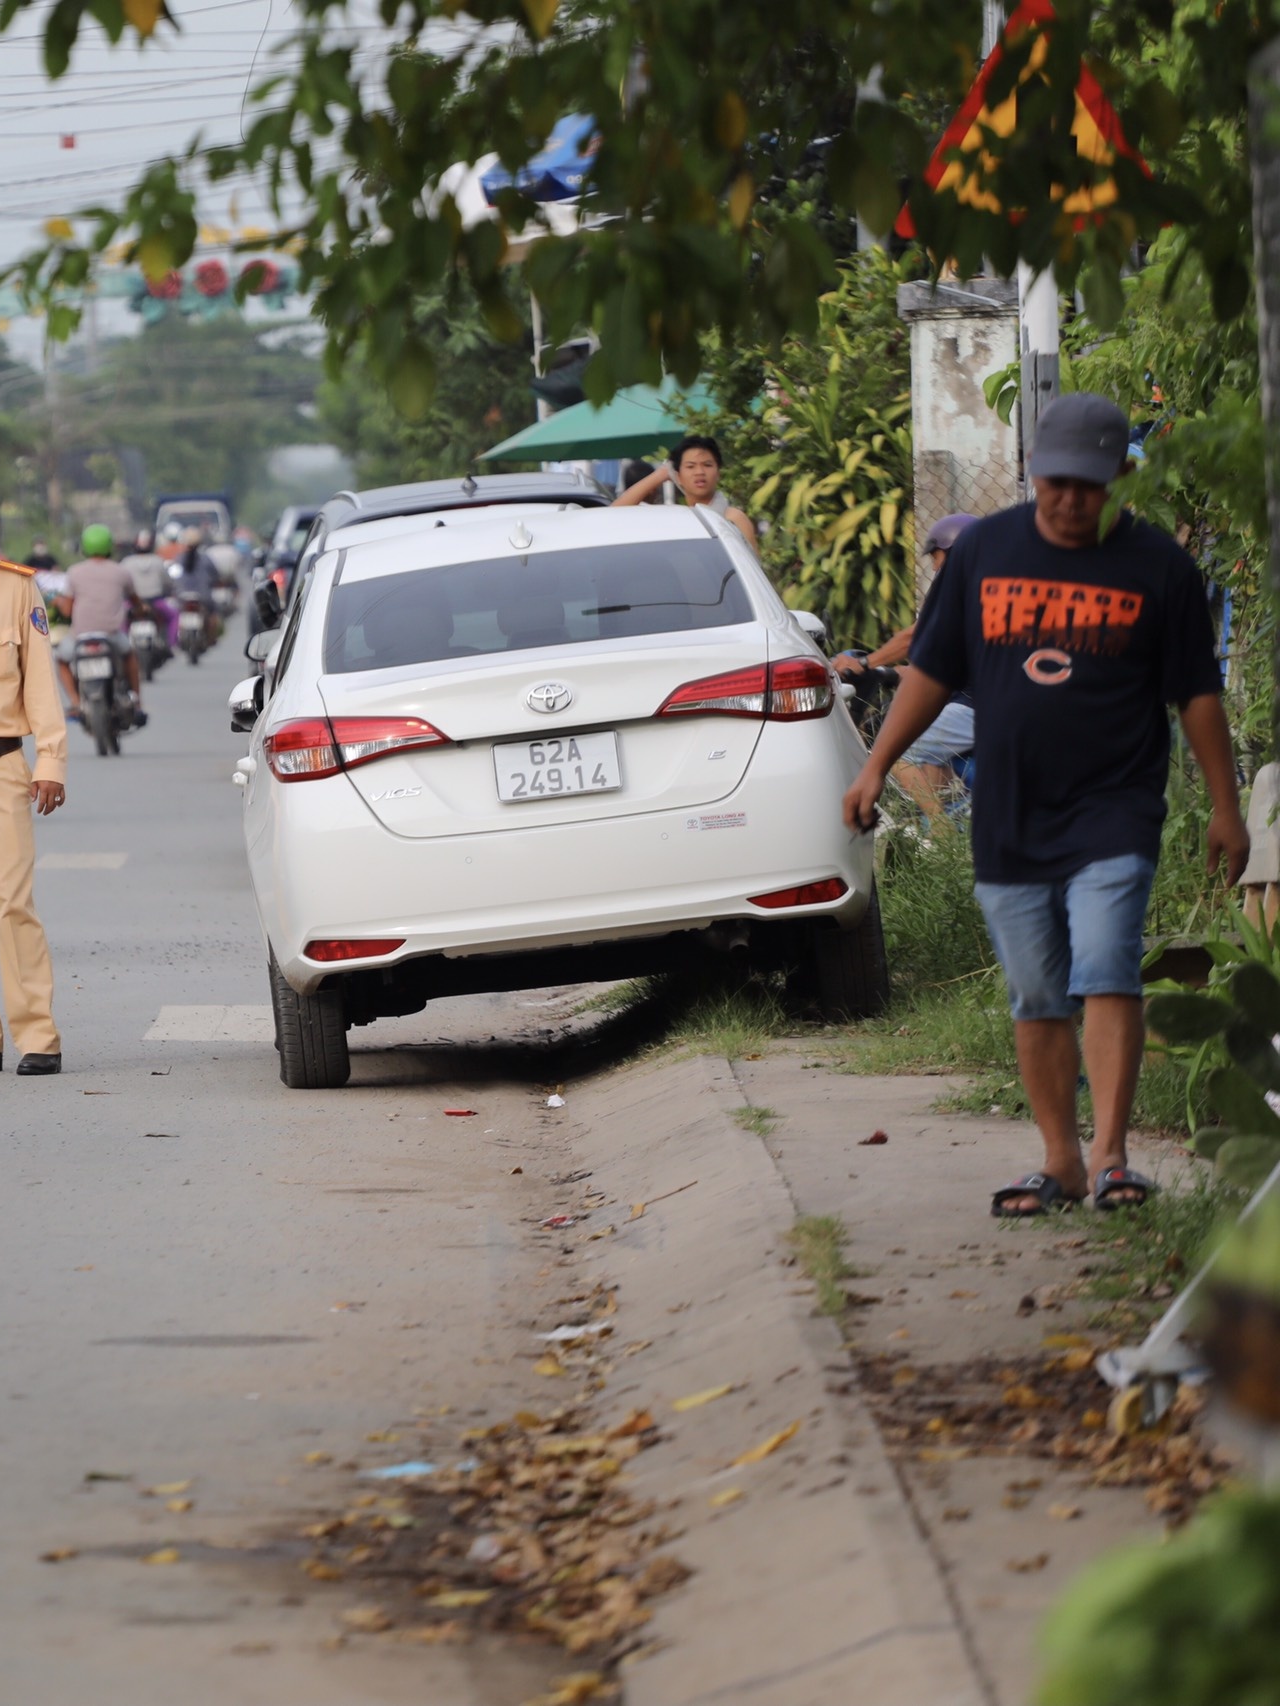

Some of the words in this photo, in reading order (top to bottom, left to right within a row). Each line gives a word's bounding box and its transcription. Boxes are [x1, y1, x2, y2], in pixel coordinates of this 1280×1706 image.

[985, 583, 1137, 613] CHICAGO
[528, 737, 583, 766] 62A
[510, 762, 608, 798] 249.14
